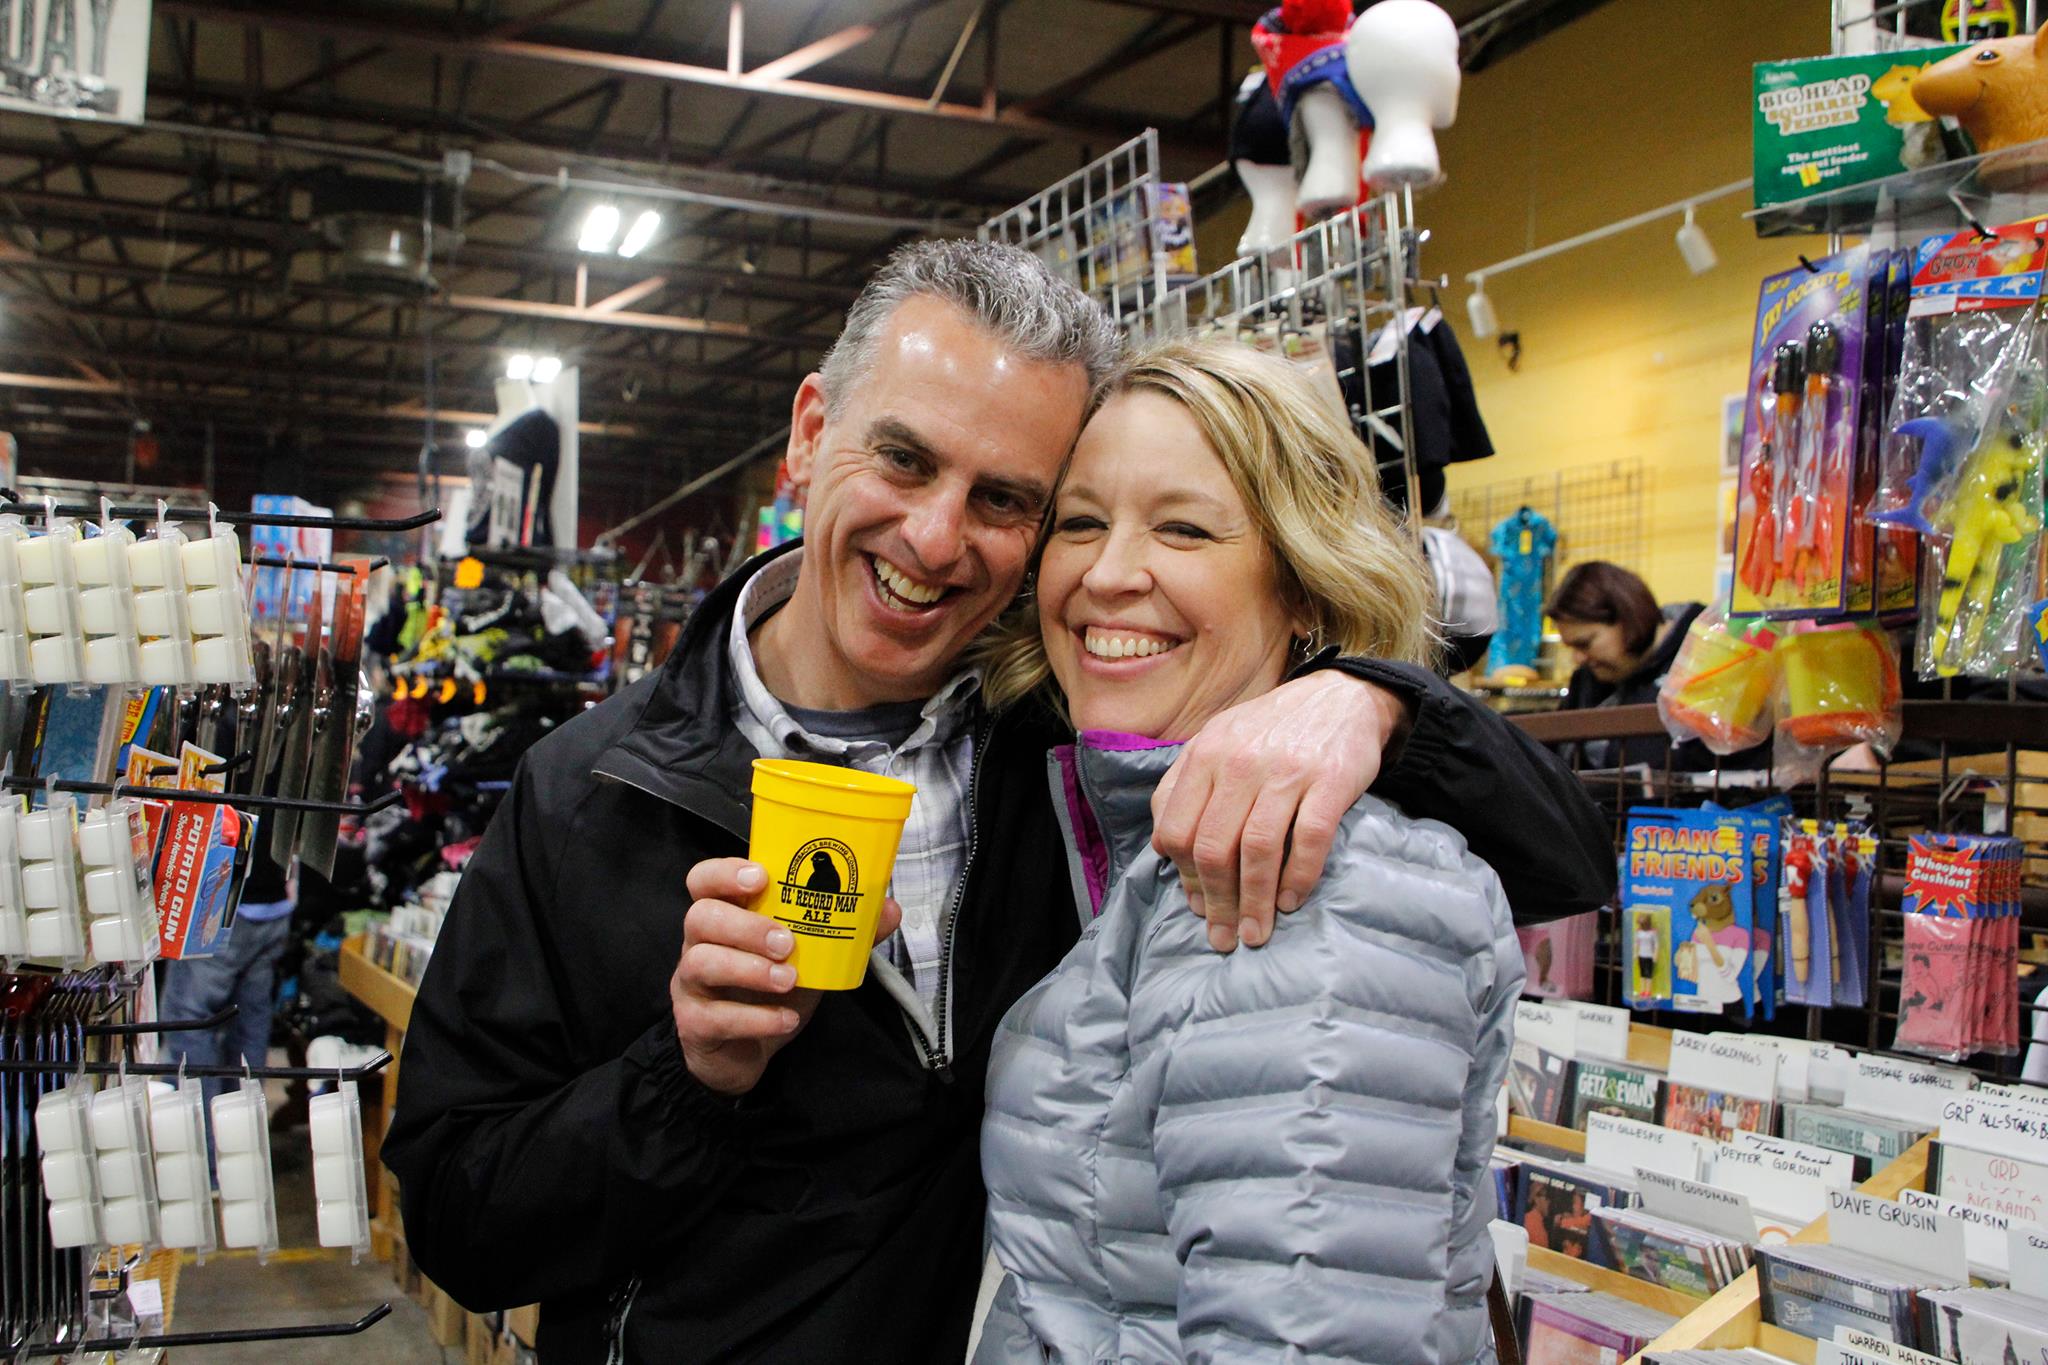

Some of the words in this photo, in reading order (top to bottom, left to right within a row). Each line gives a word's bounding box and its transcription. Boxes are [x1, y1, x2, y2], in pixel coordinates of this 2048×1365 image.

[1762, 89, 1798, 109] BIG
[1806, 78, 1866, 100] HEAD
[1787, 152, 1810, 163] The
[1830, 151, 1869, 165] feeder
[1819, 166, 1841, 177] ver!
[175, 813, 204, 894] POTATO
[1914, 855, 1973, 877] Whoopee
[1630, 850, 1745, 885] FRIENDS
[1910, 868, 1971, 890] Cushion!
[795, 890, 834, 911] RECORD
[833, 895, 859, 913] MAN
[163, 895, 185, 942] GUN
[801, 909, 833, 924] ALE
[1577, 1072, 1607, 1099] GETZ
[1943, 1101, 1974, 1125] GRP
[1979, 1112, 2038, 1137] ALL-STARS
[1772, 1157, 1821, 1179] GORDON
[1636, 1168, 1677, 1191] BENNY
[1681, 1181, 1740, 1207] GOODMAN
[1830, 1190, 1873, 1216] DAVE
[1878, 1203, 1938, 1233] GRUSIN
[1905, 1190, 1939, 1210] DON
[1948, 1204, 2009, 1231] GRUSIN
[1848, 1332, 1890, 1357] WARREN
